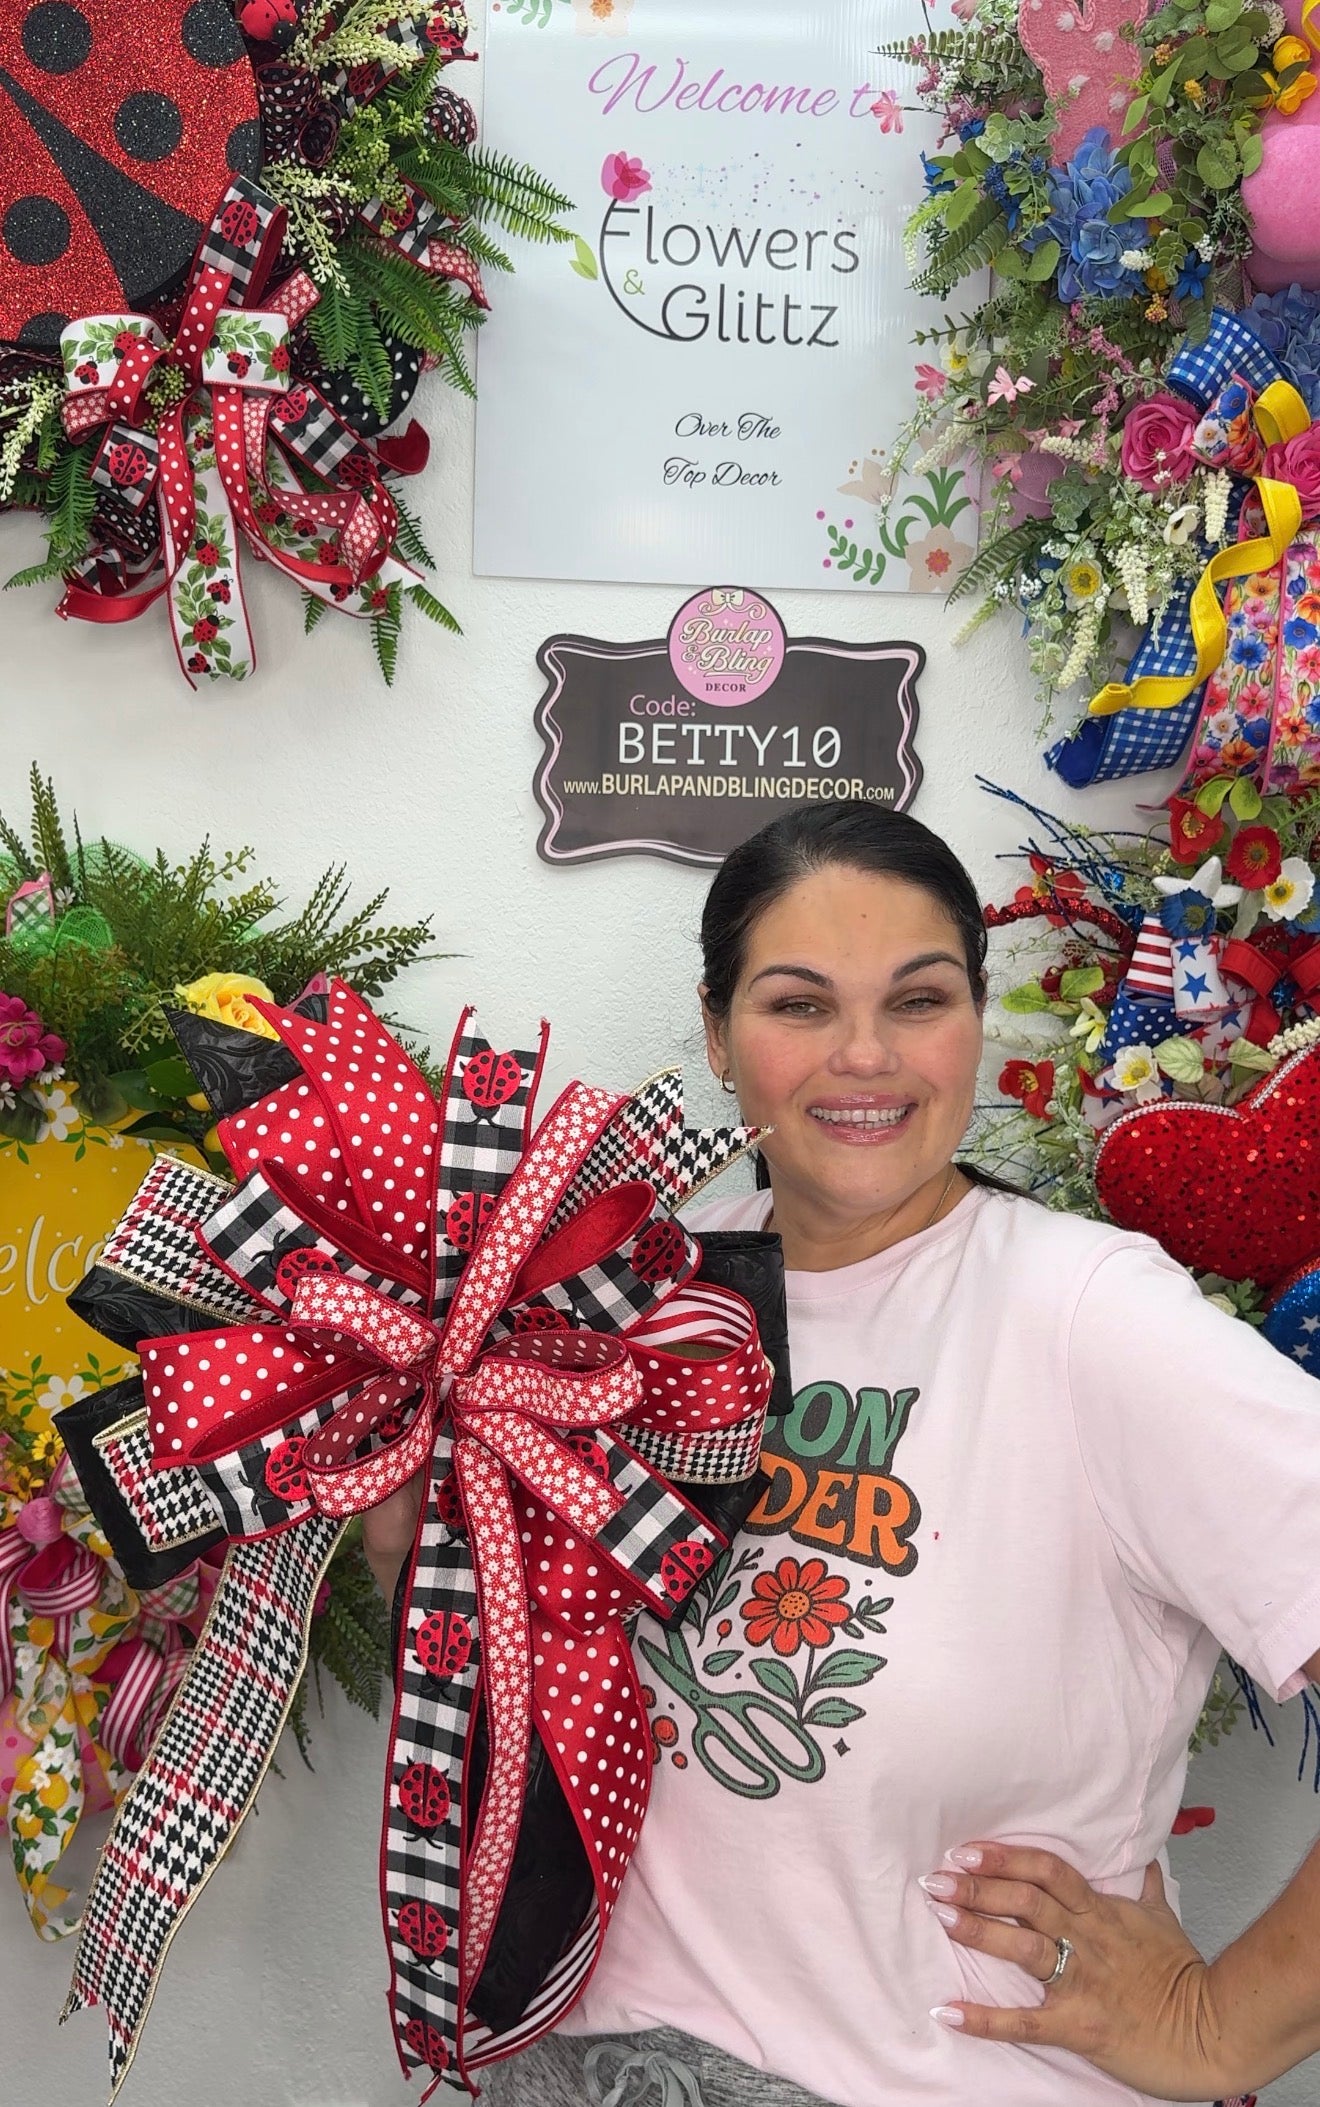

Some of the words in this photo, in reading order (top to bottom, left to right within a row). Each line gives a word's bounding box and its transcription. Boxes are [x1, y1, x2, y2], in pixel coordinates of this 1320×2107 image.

[588, 53, 840, 116] Welcome
[600, 200, 860, 274] Flowers
[622, 269, 646, 296] &
[660, 282, 840, 348] Glittz
[674, 413, 732, 440] Over
[736, 412, 781, 440] The
[663, 457, 706, 487] Top
[711, 461, 782, 488] Decor
[680, 617, 773, 651] Burlap
[681, 645, 699, 662] &
[696, 644, 775, 685] Bling
[629, 694, 696, 717] Code:
[705, 683, 747, 692] DECOR
[618, 722, 842, 768] BETTY10
[763, 1381, 919, 1467] ON
